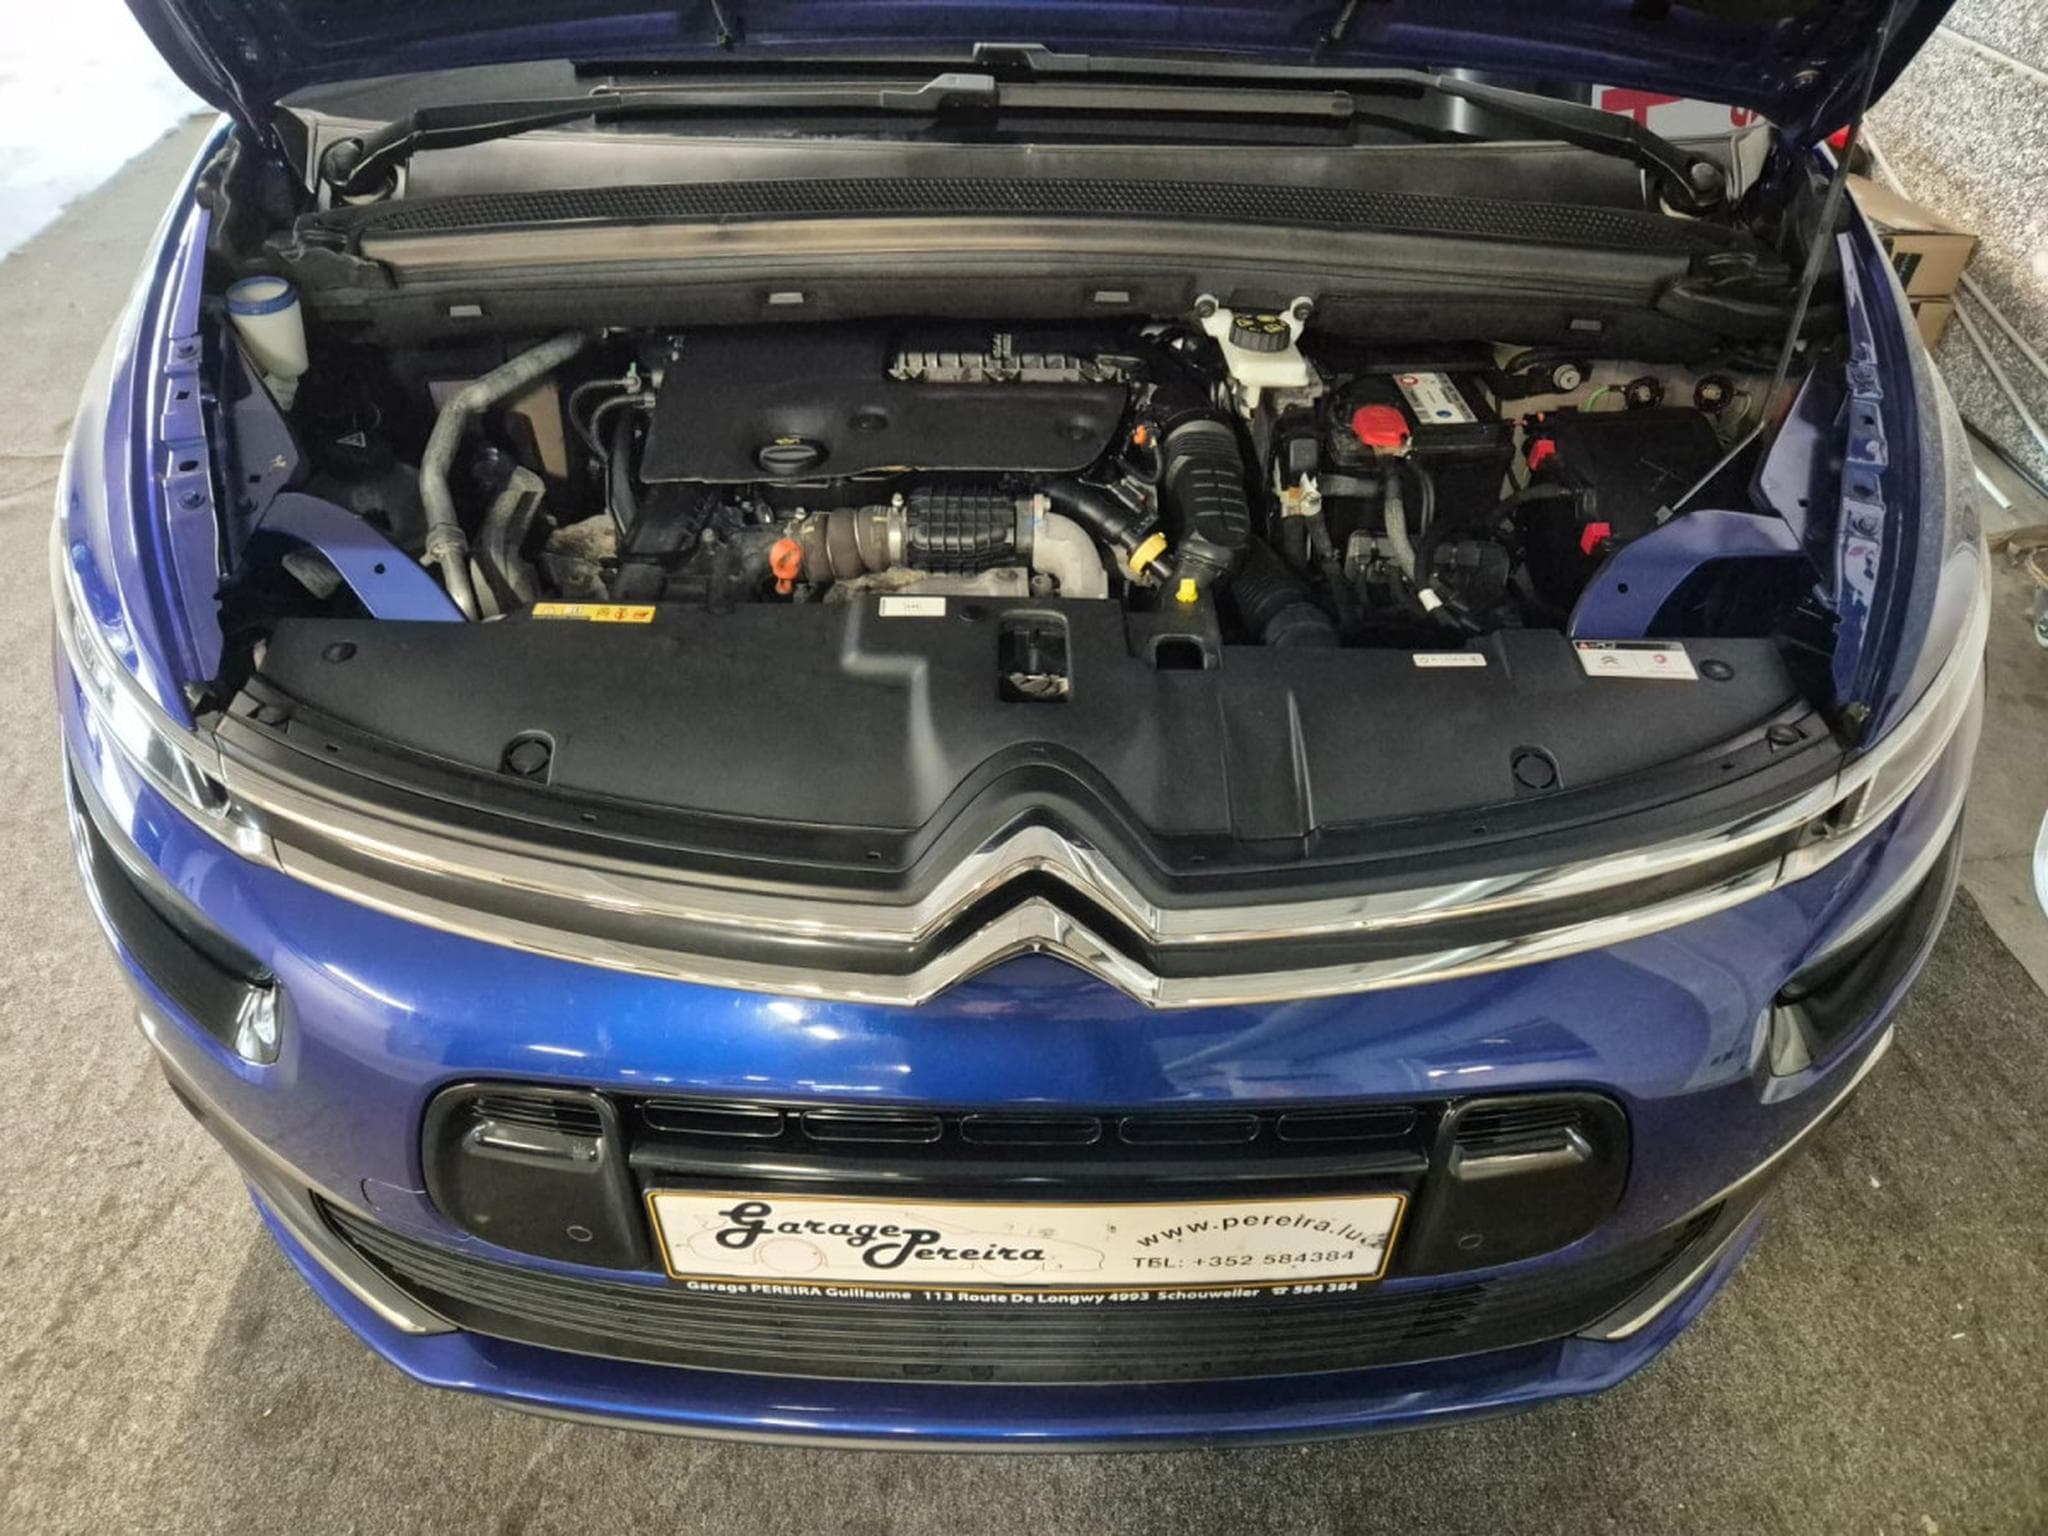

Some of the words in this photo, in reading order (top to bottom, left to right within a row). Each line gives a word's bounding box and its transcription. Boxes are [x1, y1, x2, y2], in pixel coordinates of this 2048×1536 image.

[715, 1201, 902, 1249] Garage
[861, 1228, 1046, 1270] Pereira
[1194, 1254, 1253, 1268] +352
[1263, 1249, 1355, 1265] 584384
[686, 1280, 748, 1295] Garage
[750, 1284, 822, 1297] PEREIRA
[826, 1288, 912, 1300] Guillaume
[923, 1291, 954, 1302] 113
[958, 1293, 1008, 1303] Route
[1011, 1293, 1034, 1304] De
[1036, 1292, 1104, 1305] Longwy
[1108, 1291, 1150, 1302] 4993
